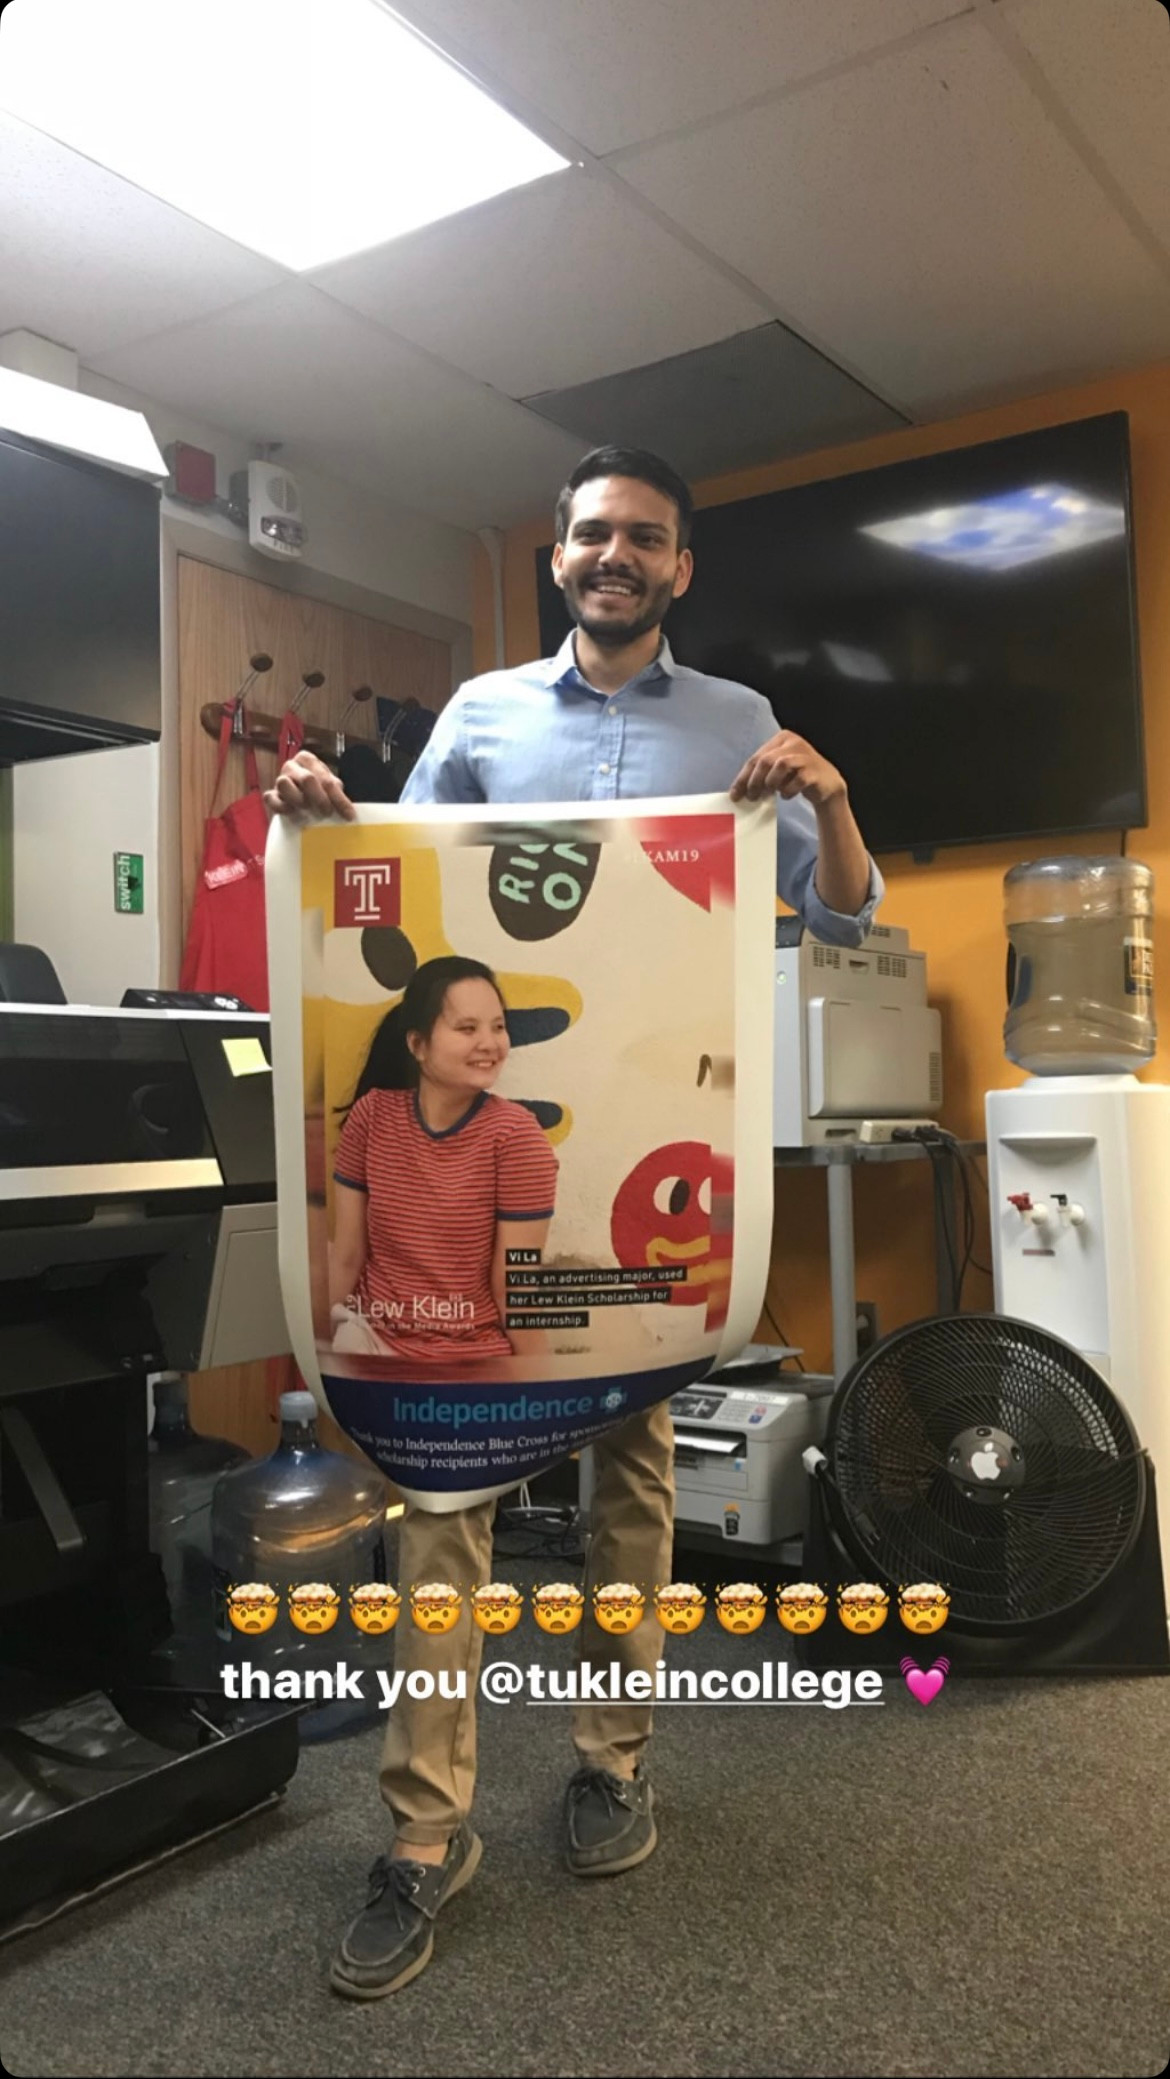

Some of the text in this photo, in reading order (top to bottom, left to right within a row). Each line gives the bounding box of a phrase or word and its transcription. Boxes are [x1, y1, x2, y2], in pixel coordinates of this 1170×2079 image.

[117, 855, 131, 910] switch
[509, 1252, 537, 1262] Vi La
[543, 1274, 556, 1283] an
[558, 1270, 620, 1283] advertising
[622, 1268, 655, 1281] major,
[658, 1268, 683, 1280] used
[357, 1294, 475, 1320] Lew Klein
[509, 1289, 668, 1304] her Lew Klein Scholarship for
[509, 1316, 523, 1326] an
[394, 1395, 593, 1429] Independence
[393, 1438, 403, 1447] to
[405, 1437, 486, 1453] Independence
[488, 1435, 514, 1450] Blue
[516, 1434, 548, 1448] Cross
[551, 1430, 567, 1441] for
[430, 1456, 488, 1471] recipients
[491, 1453, 517, 1466] who
[519, 1451, 538, 1460] are
[539, 1448, 550, 1457] in
